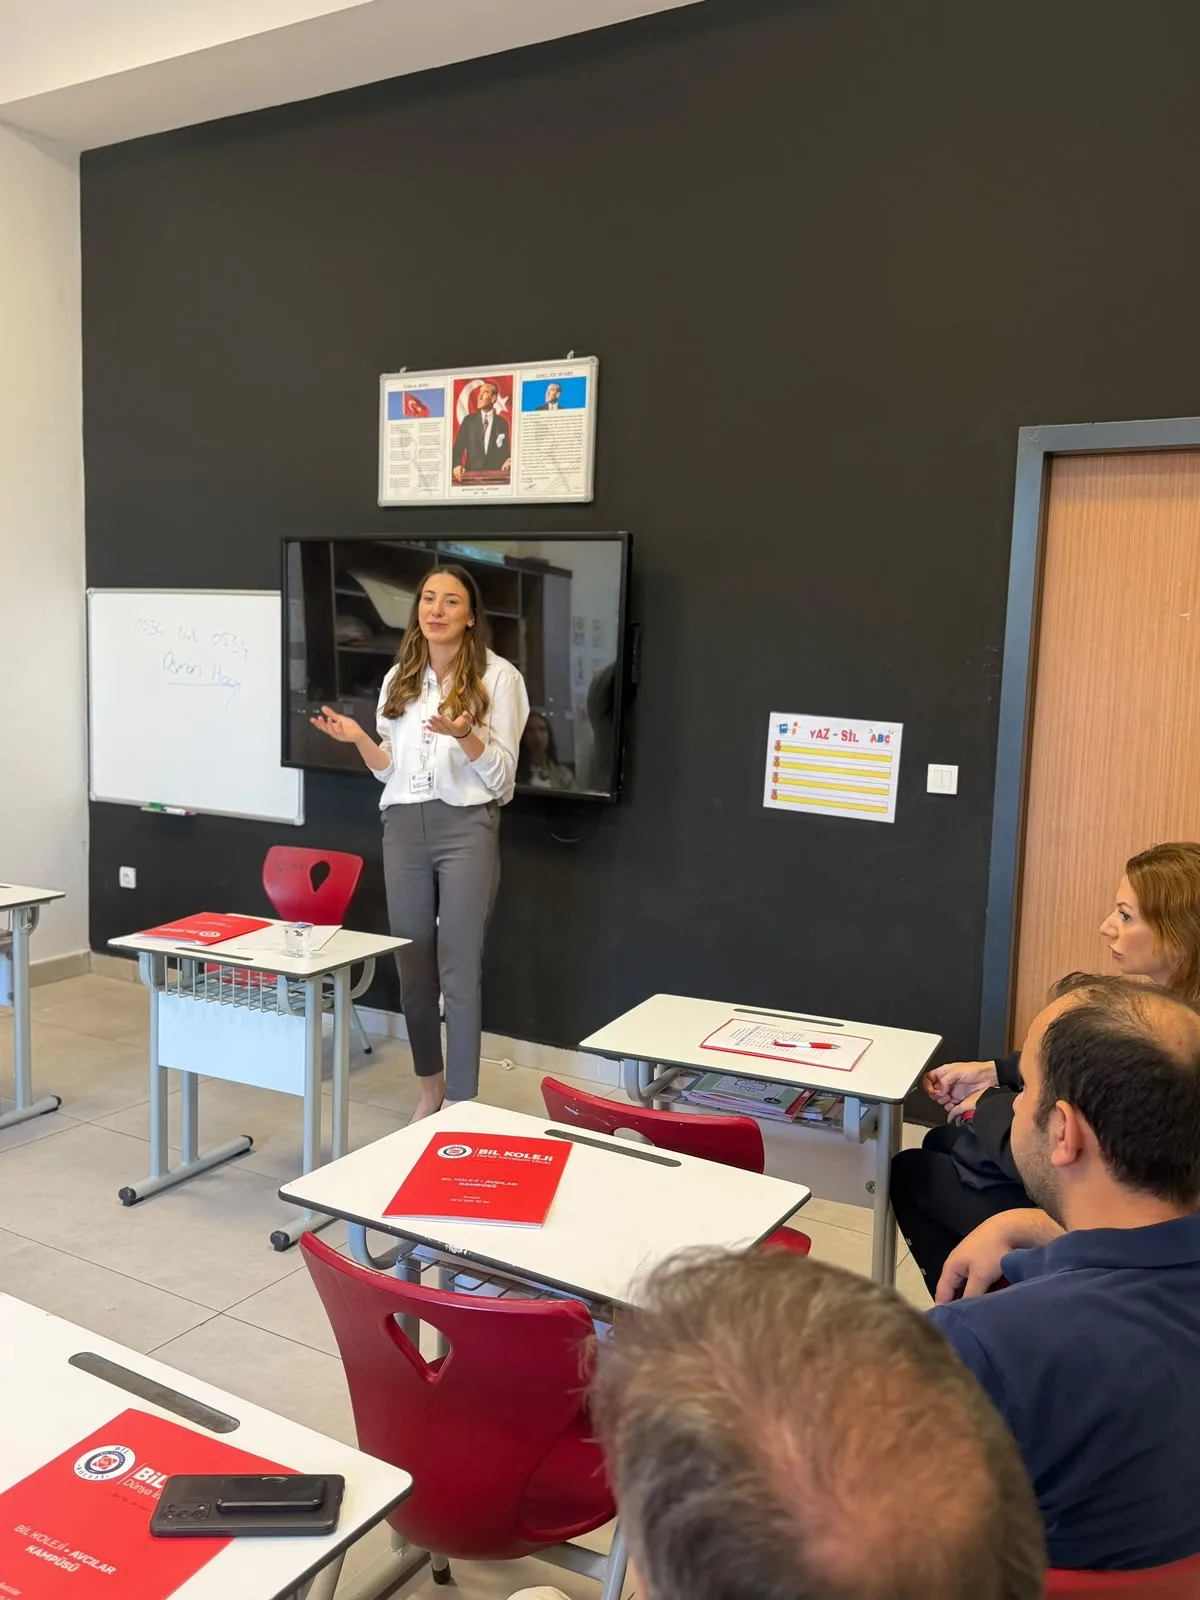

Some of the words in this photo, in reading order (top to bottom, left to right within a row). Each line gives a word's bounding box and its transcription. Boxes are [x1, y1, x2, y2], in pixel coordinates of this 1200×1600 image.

[810, 728, 830, 740] YAZ
[841, 729, 859, 743] SİL
[870, 733, 891, 744] ABC
[123, 1478, 152, 1496] Dünya
[13, 1524, 31, 1536] BİL
[68, 1550, 117, 1575] AVCILAR
[25, 1544, 81, 1573] KAMPÜSÜ
